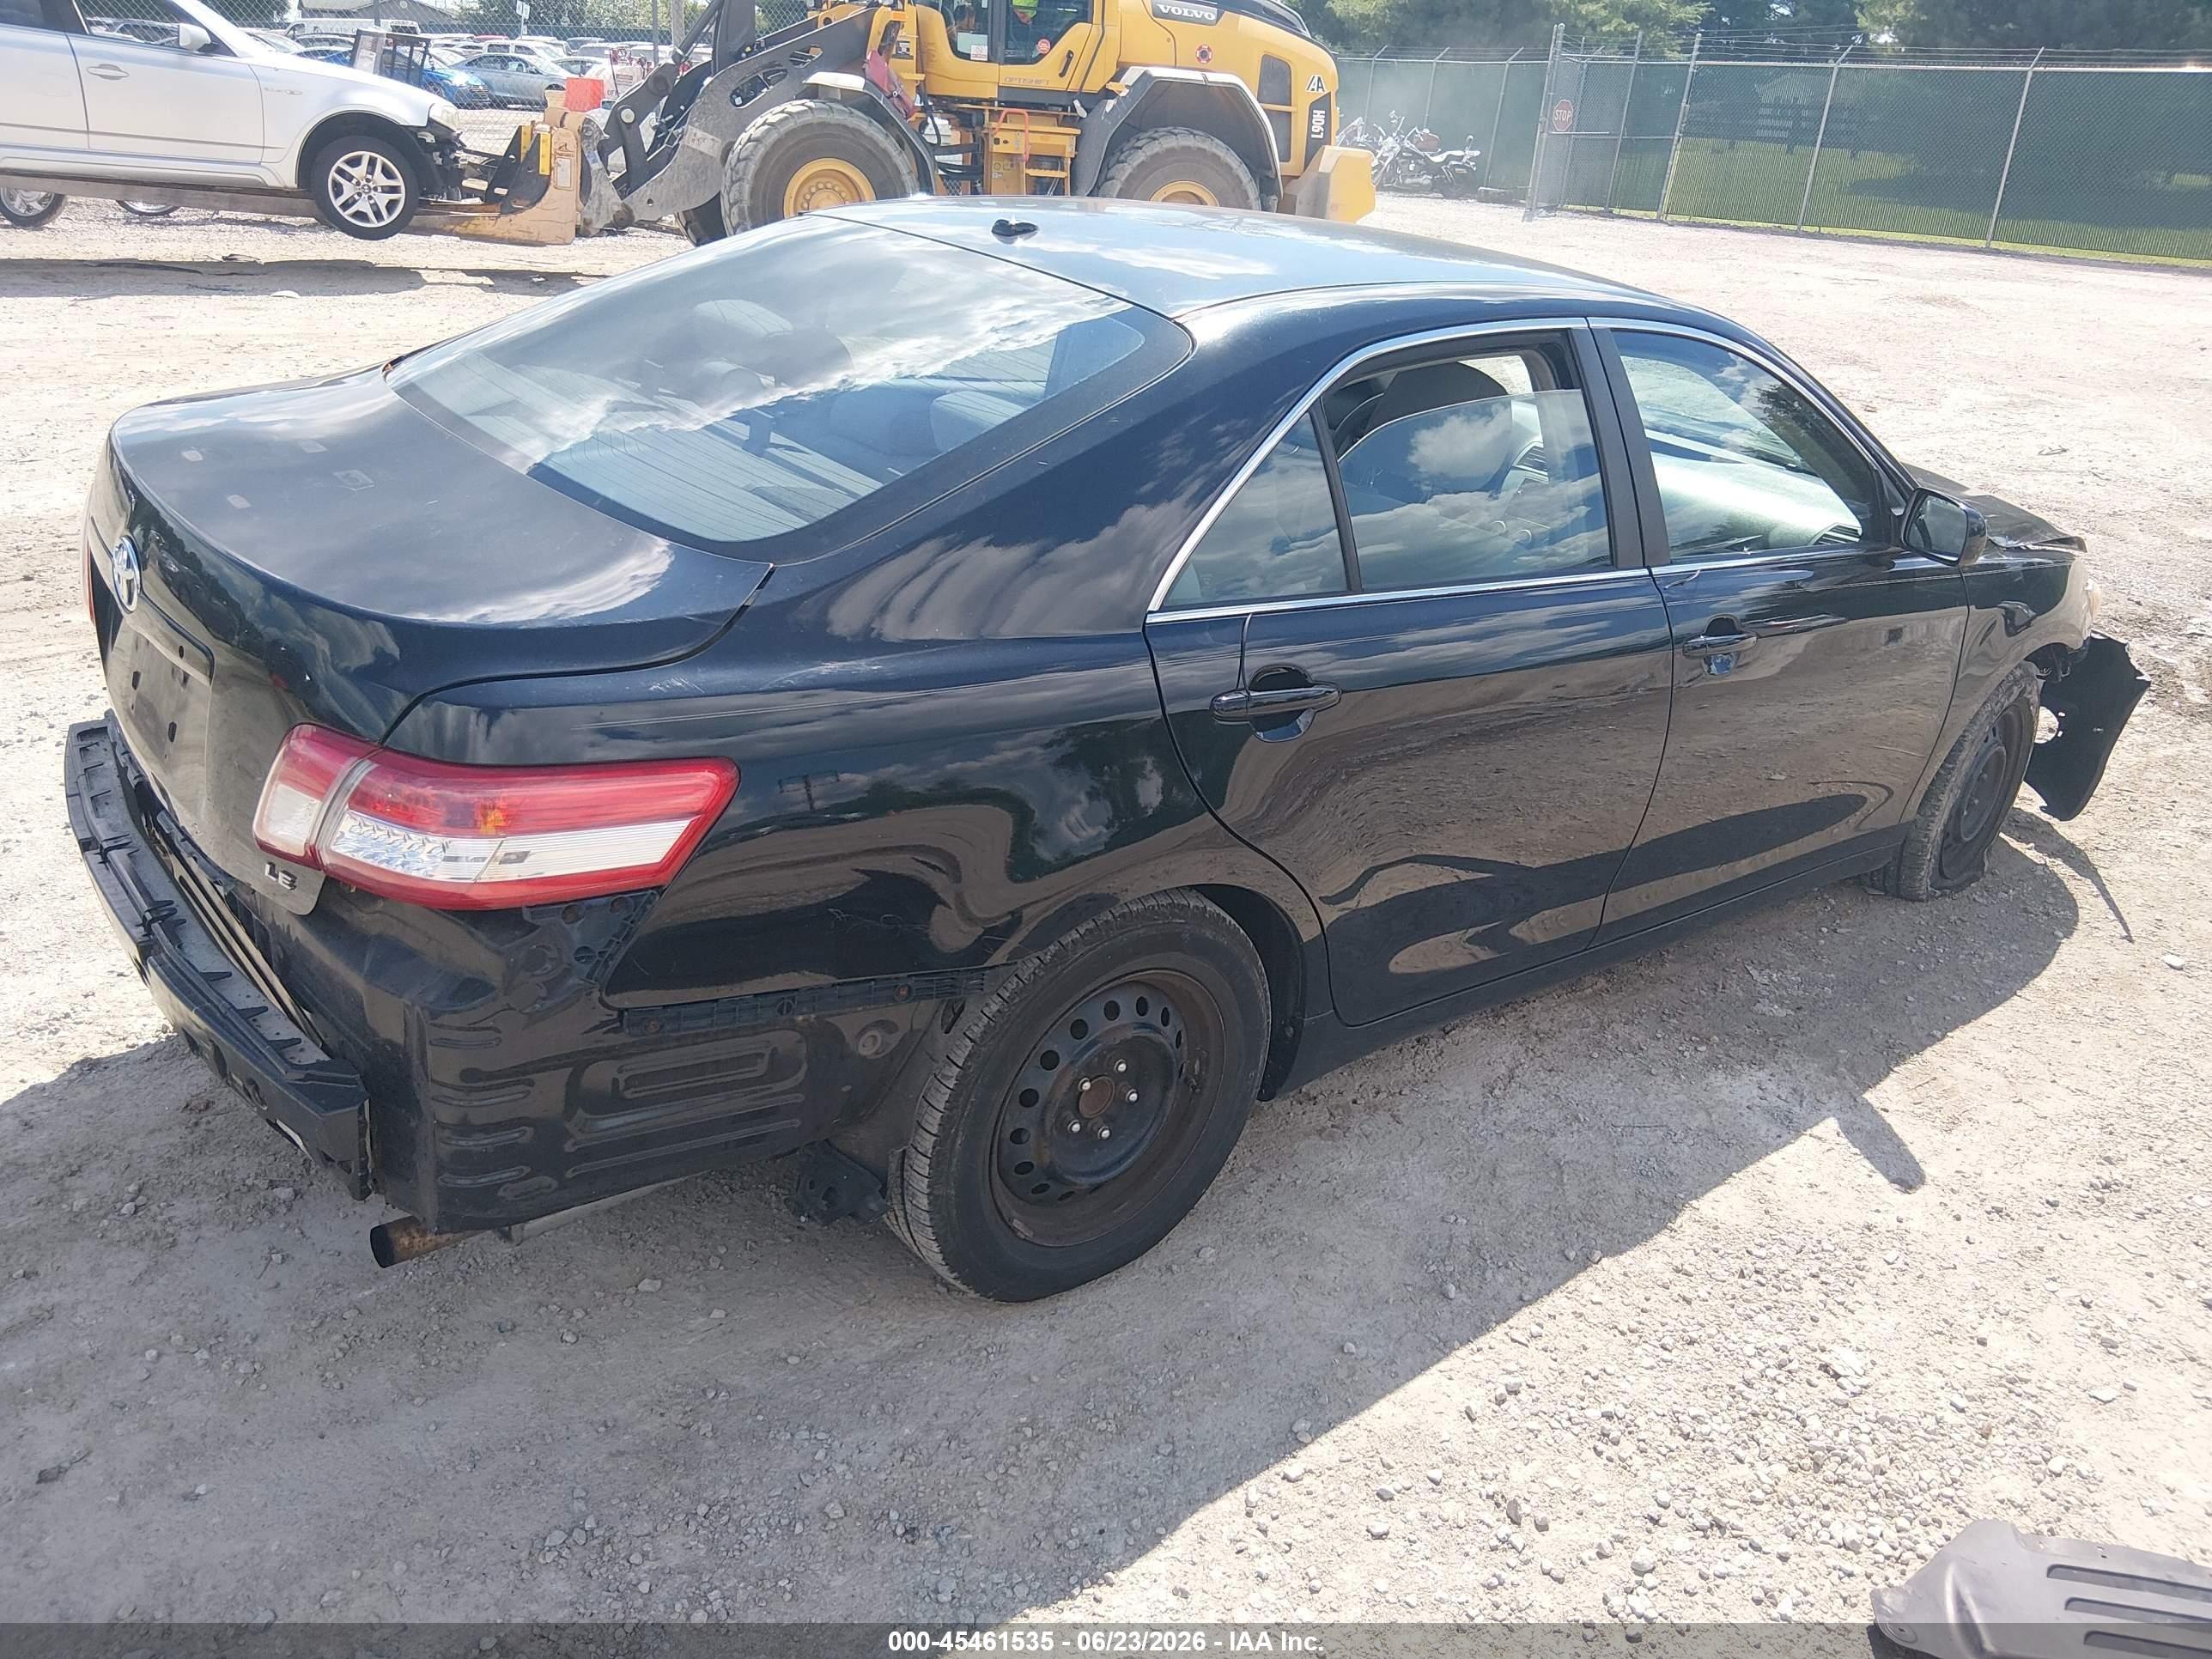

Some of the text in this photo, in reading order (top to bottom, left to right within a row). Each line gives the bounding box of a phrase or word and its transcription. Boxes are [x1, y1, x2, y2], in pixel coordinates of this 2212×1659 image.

[1157, 3, 1216, 21] VOLVO
[1310, 109, 1326, 139] L90H
[1554, 109, 1572, 122] STOP
[264, 861, 297, 890] LE
